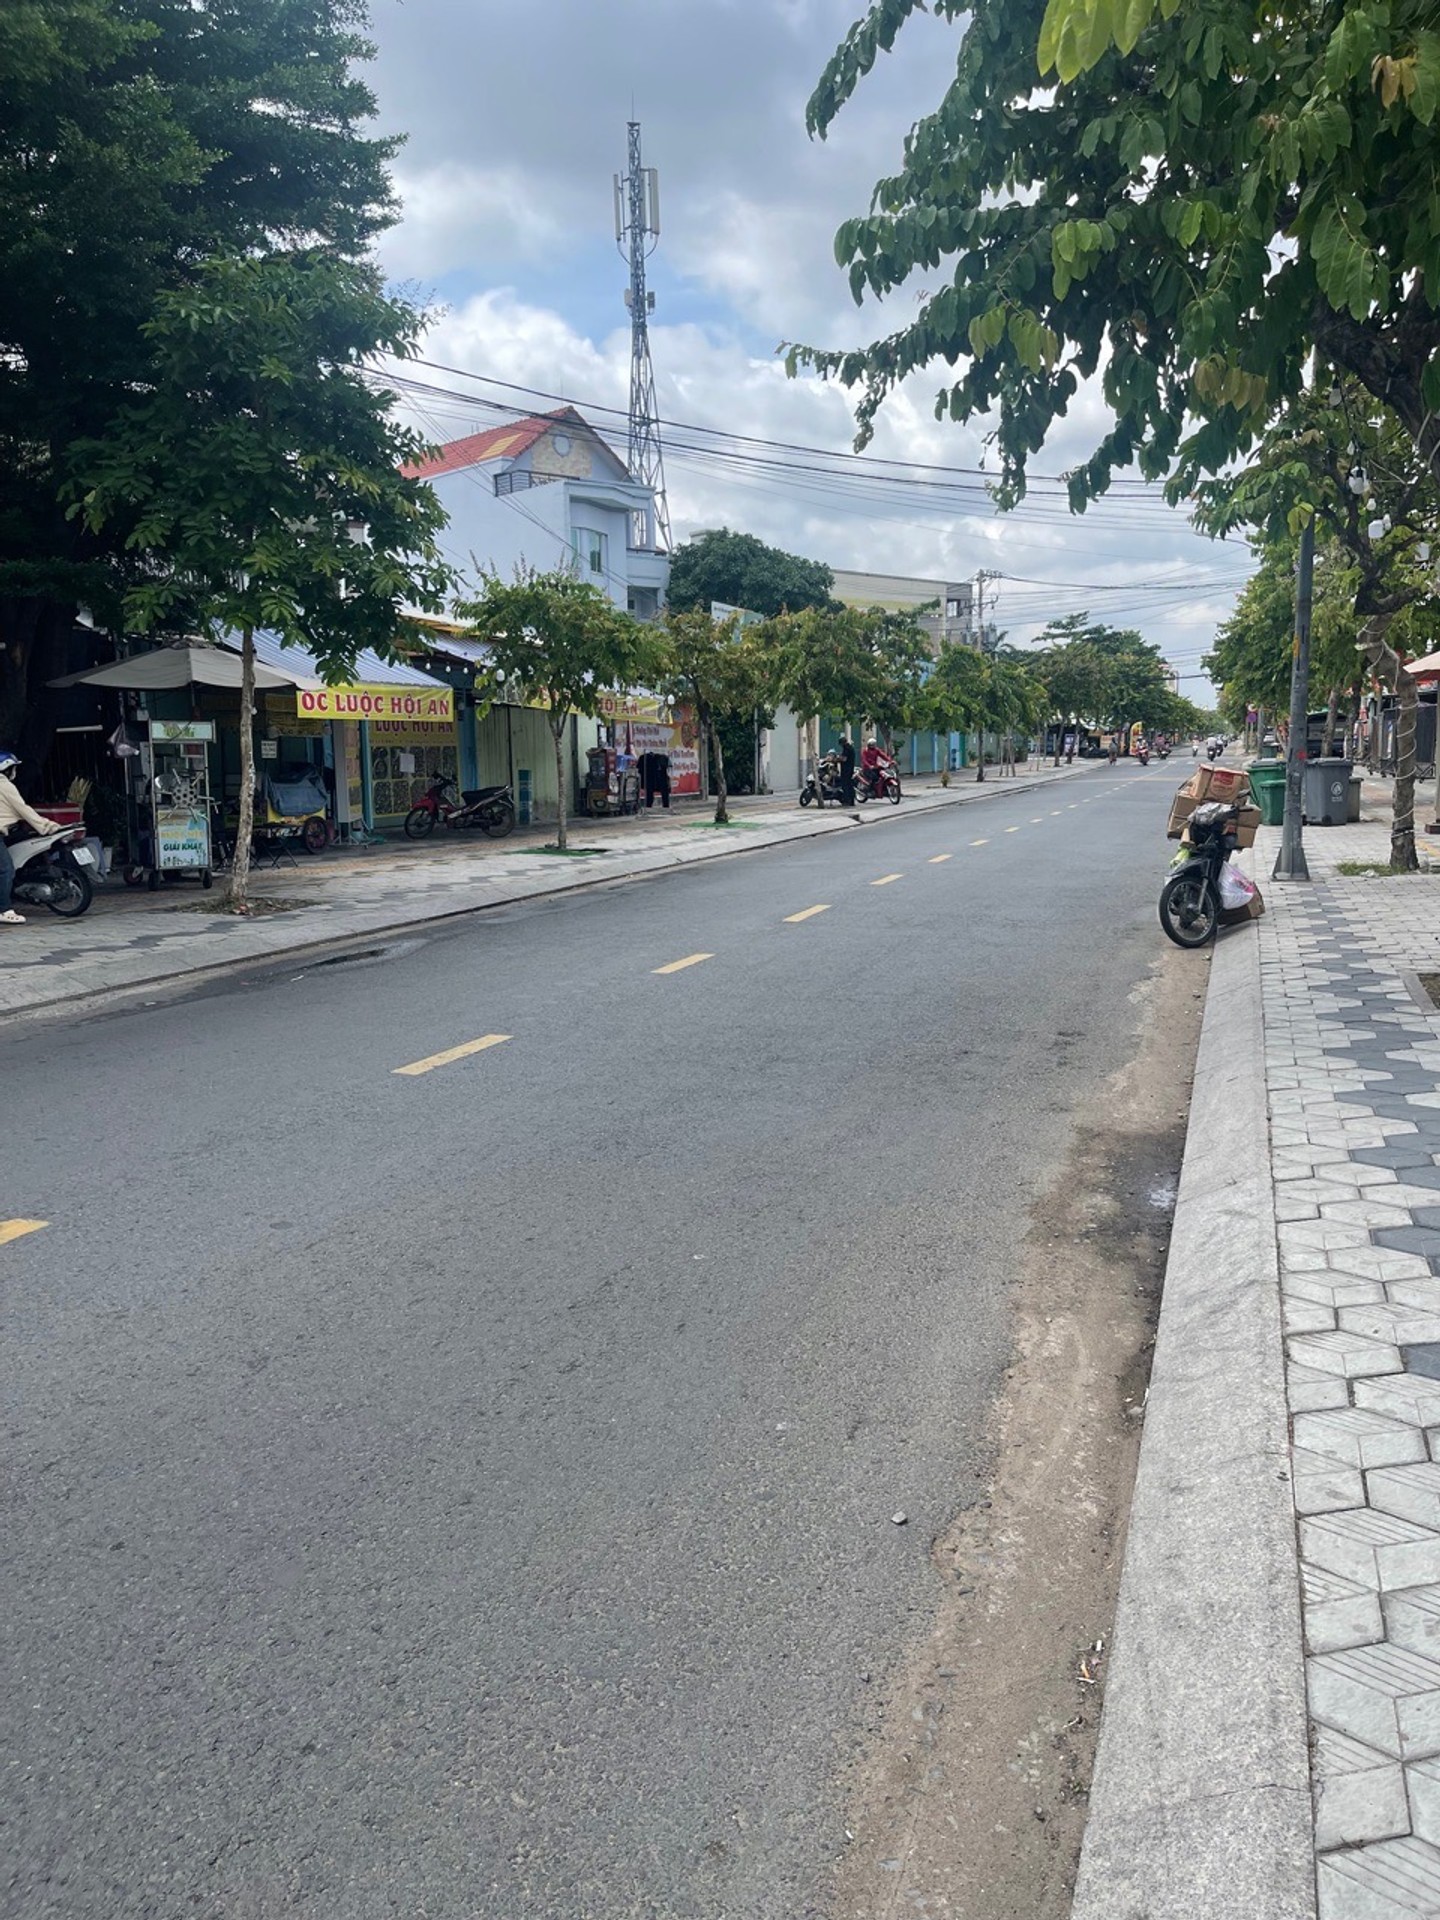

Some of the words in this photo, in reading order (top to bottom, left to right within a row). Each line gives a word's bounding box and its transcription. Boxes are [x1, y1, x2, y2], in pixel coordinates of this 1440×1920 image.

[335, 690, 384, 718] LUỘC
[391, 693, 421, 719] HỘI
[427, 699, 449, 715] AN
